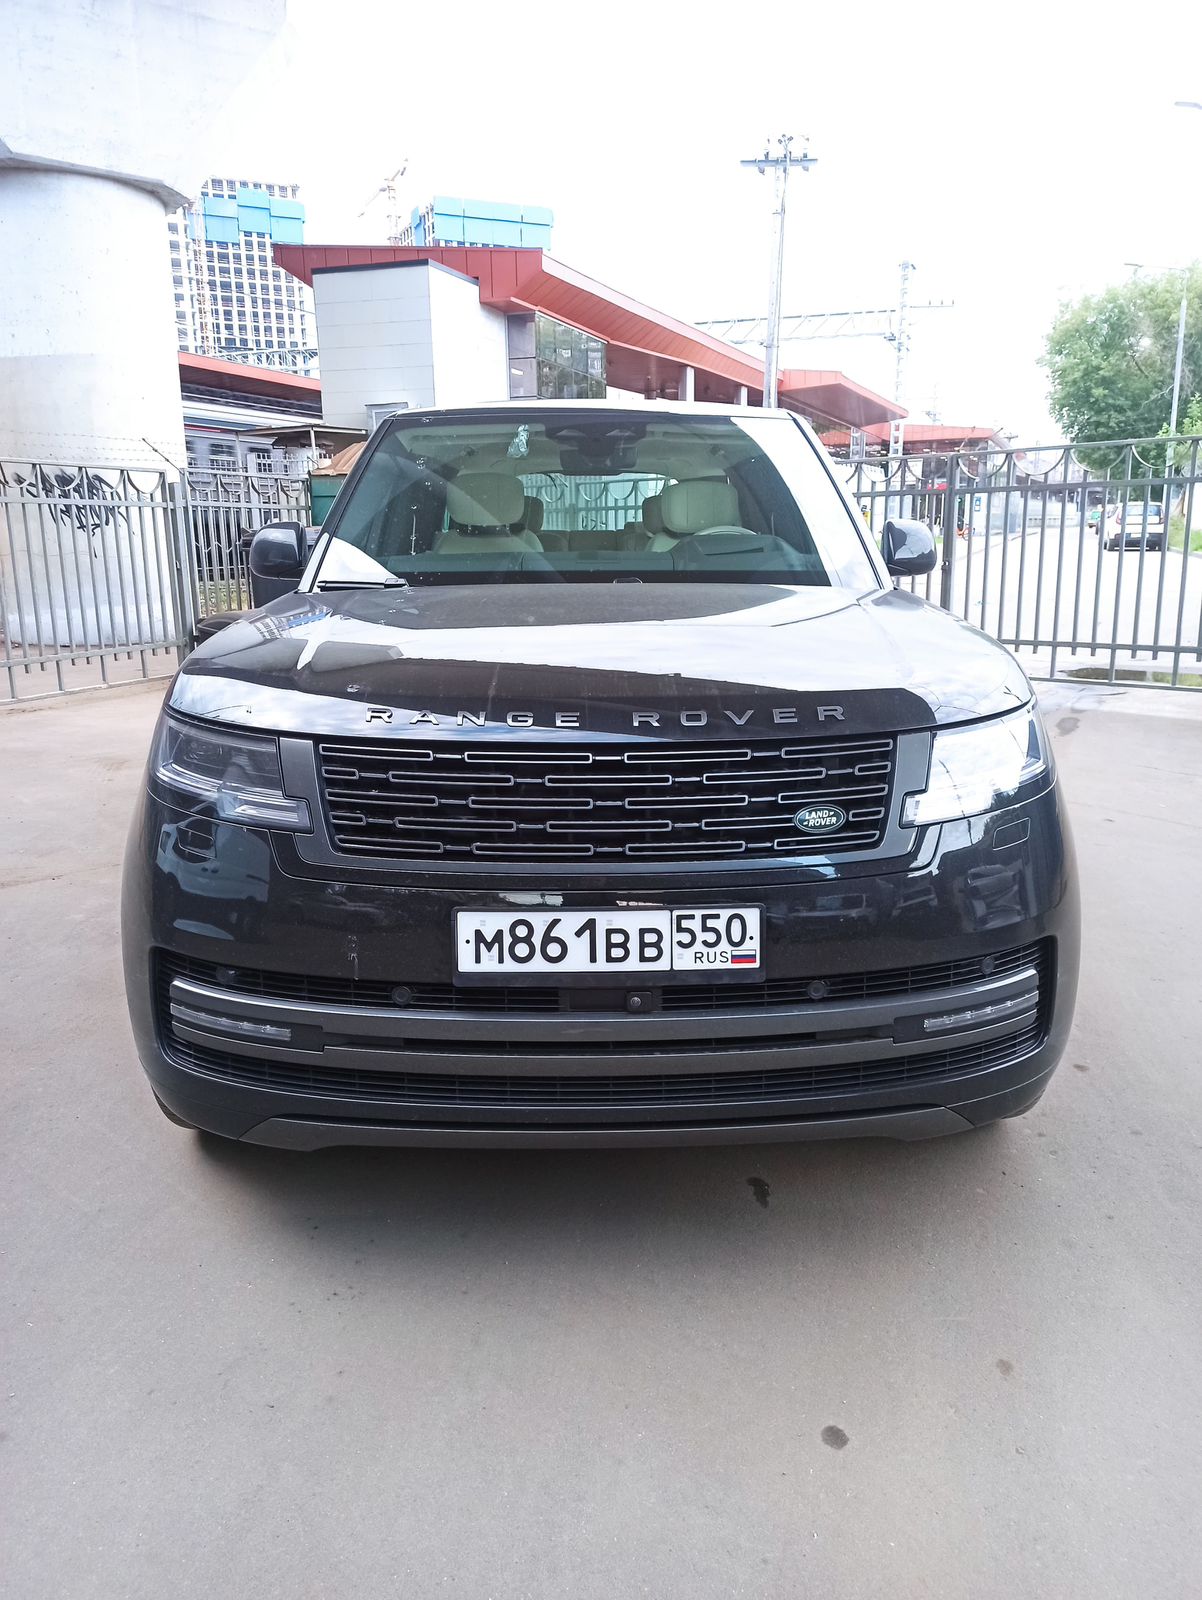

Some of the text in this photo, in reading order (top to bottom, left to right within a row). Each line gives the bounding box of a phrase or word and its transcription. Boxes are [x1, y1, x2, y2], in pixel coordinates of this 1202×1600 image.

[365, 705, 845, 728] RANGE ROVER
[805, 810, 829, 820] LAND
[808, 816, 837, 827] ROVER
[675, 912, 748, 949] 550
[693, 950, 729, 964] RUS
